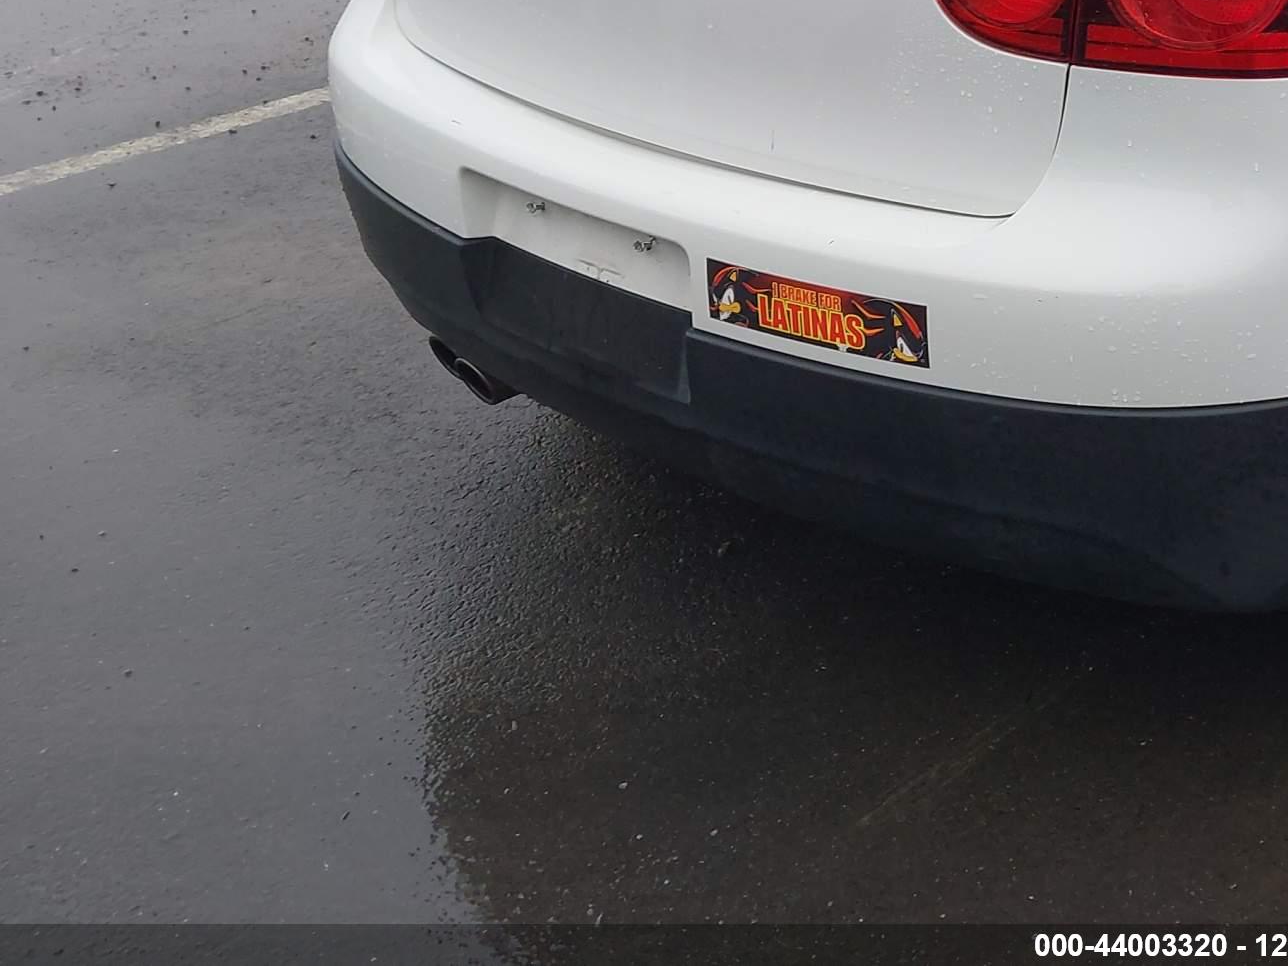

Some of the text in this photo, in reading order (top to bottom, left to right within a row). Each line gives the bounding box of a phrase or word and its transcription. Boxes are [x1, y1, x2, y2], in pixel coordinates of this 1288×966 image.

[779, 283, 818, 306] BRAKE
[818, 292, 842, 311] FOR
[757, 293, 866, 350] LATINAS
